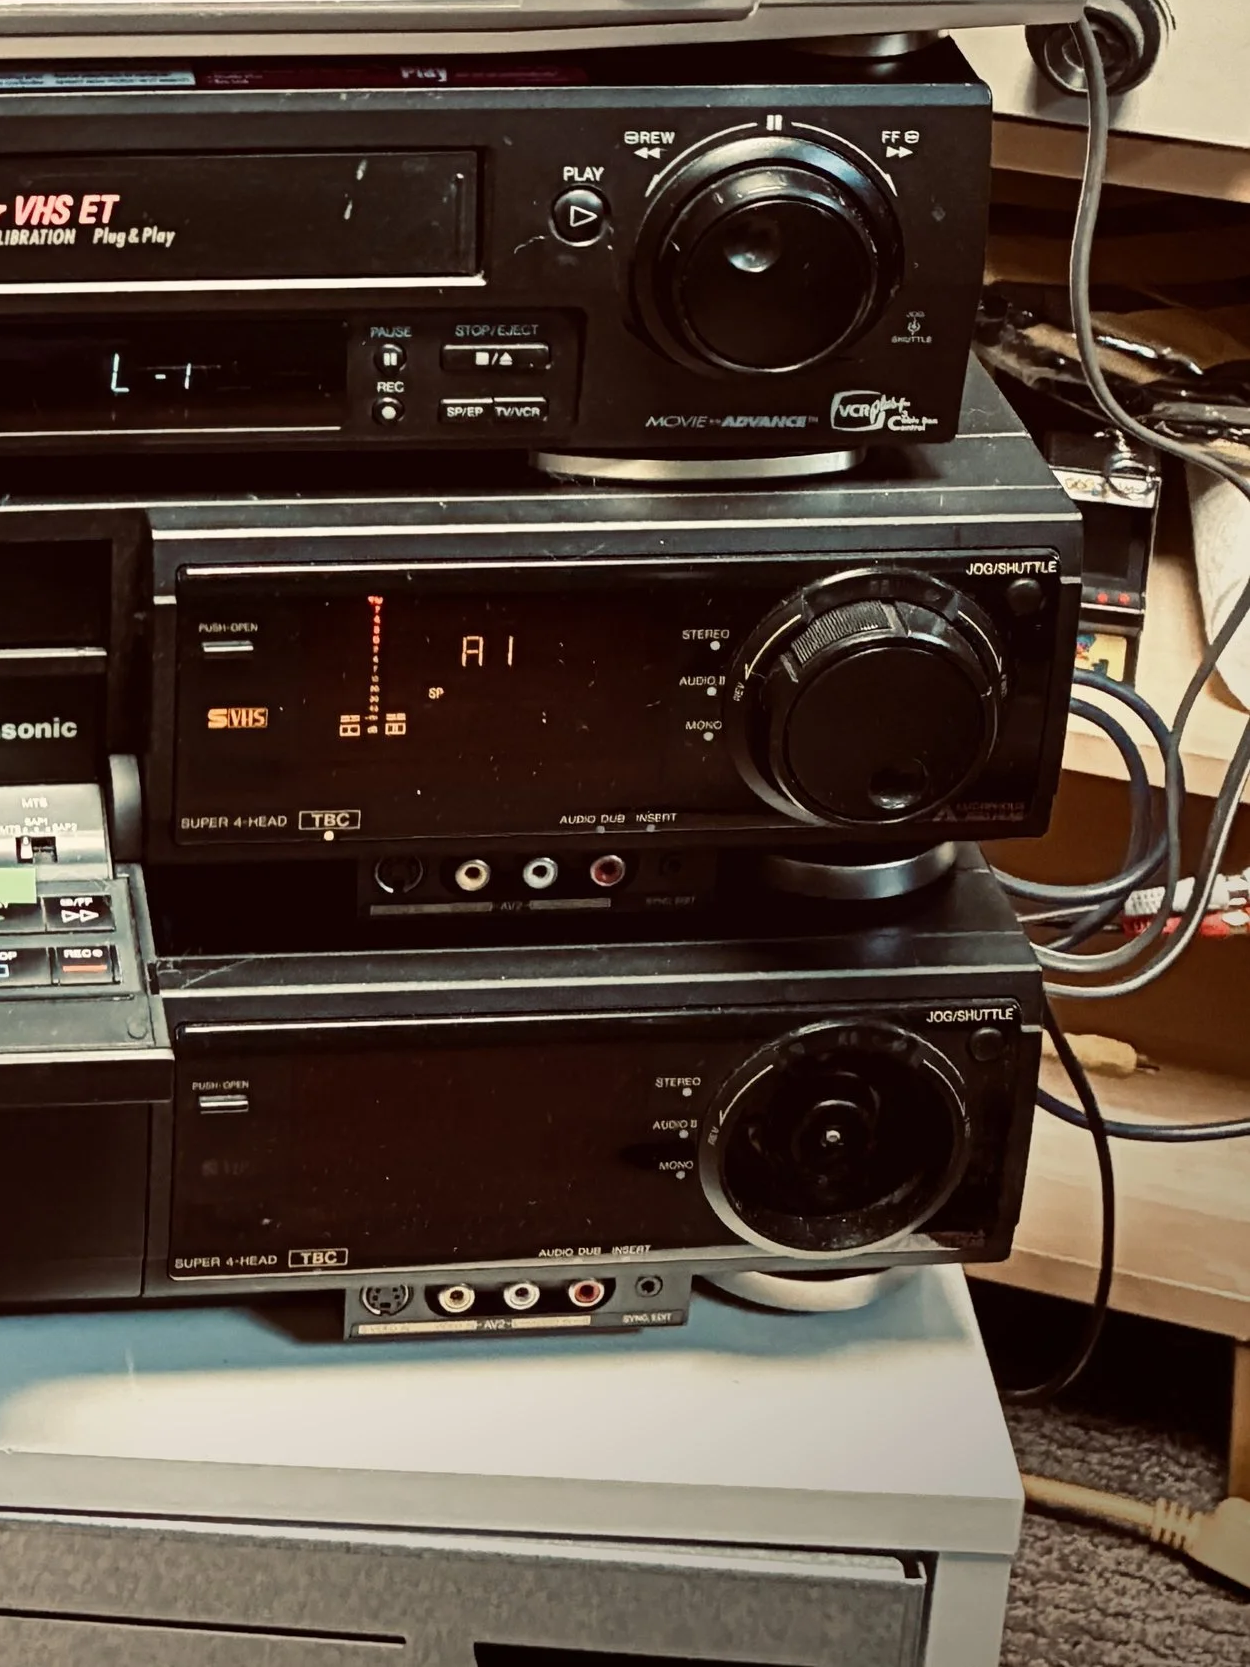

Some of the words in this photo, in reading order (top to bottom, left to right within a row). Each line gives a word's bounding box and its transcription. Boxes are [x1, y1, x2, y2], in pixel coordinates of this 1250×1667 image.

[640, 131, 676, 145] REW
[881, 130, 900, 145] FF
[562, 166, 604, 182] PLAY
[14, 194, 74, 226] VHS
[77, 194, 121, 224] ET
[92, 226, 127, 249] Plug
[127, 228, 140, 244] &
[141, 225, 176, 248] Play
[370, 325, 412, 338] PAUSE
[455, 324, 539, 337] STOP/EJECT
[377, 381, 405, 393] REC
[446, 406, 484, 418] SP/EP
[494, 405, 541, 417] TV/VCR
[645, 416, 707, 429] MOVIE
[966, 561, 1057, 575] JOG/SHUTTLE
[682, 628, 730, 641] STEREO
[685, 720, 722, 731] MONO
[180, 816, 229, 829] SUPER
[232, 814, 288, 827] 4-HEAD
[310, 812, 351, 827] TBC
[926, 1008, 1014, 1023] JOG/SHUTTLE
[655, 1076, 701, 1088] STEREO
[658, 1160, 694, 1170] MONO
[538, 1247, 574, 1259] AUDIO
[578, 1246, 602, 1257] DUB
[611, 1244, 651, 1256] INSERT
[174, 1256, 221, 1270] SUPER
[225, 1254, 278, 1268] 4-HEAD
[300, 1250, 338, 1266] TBC
